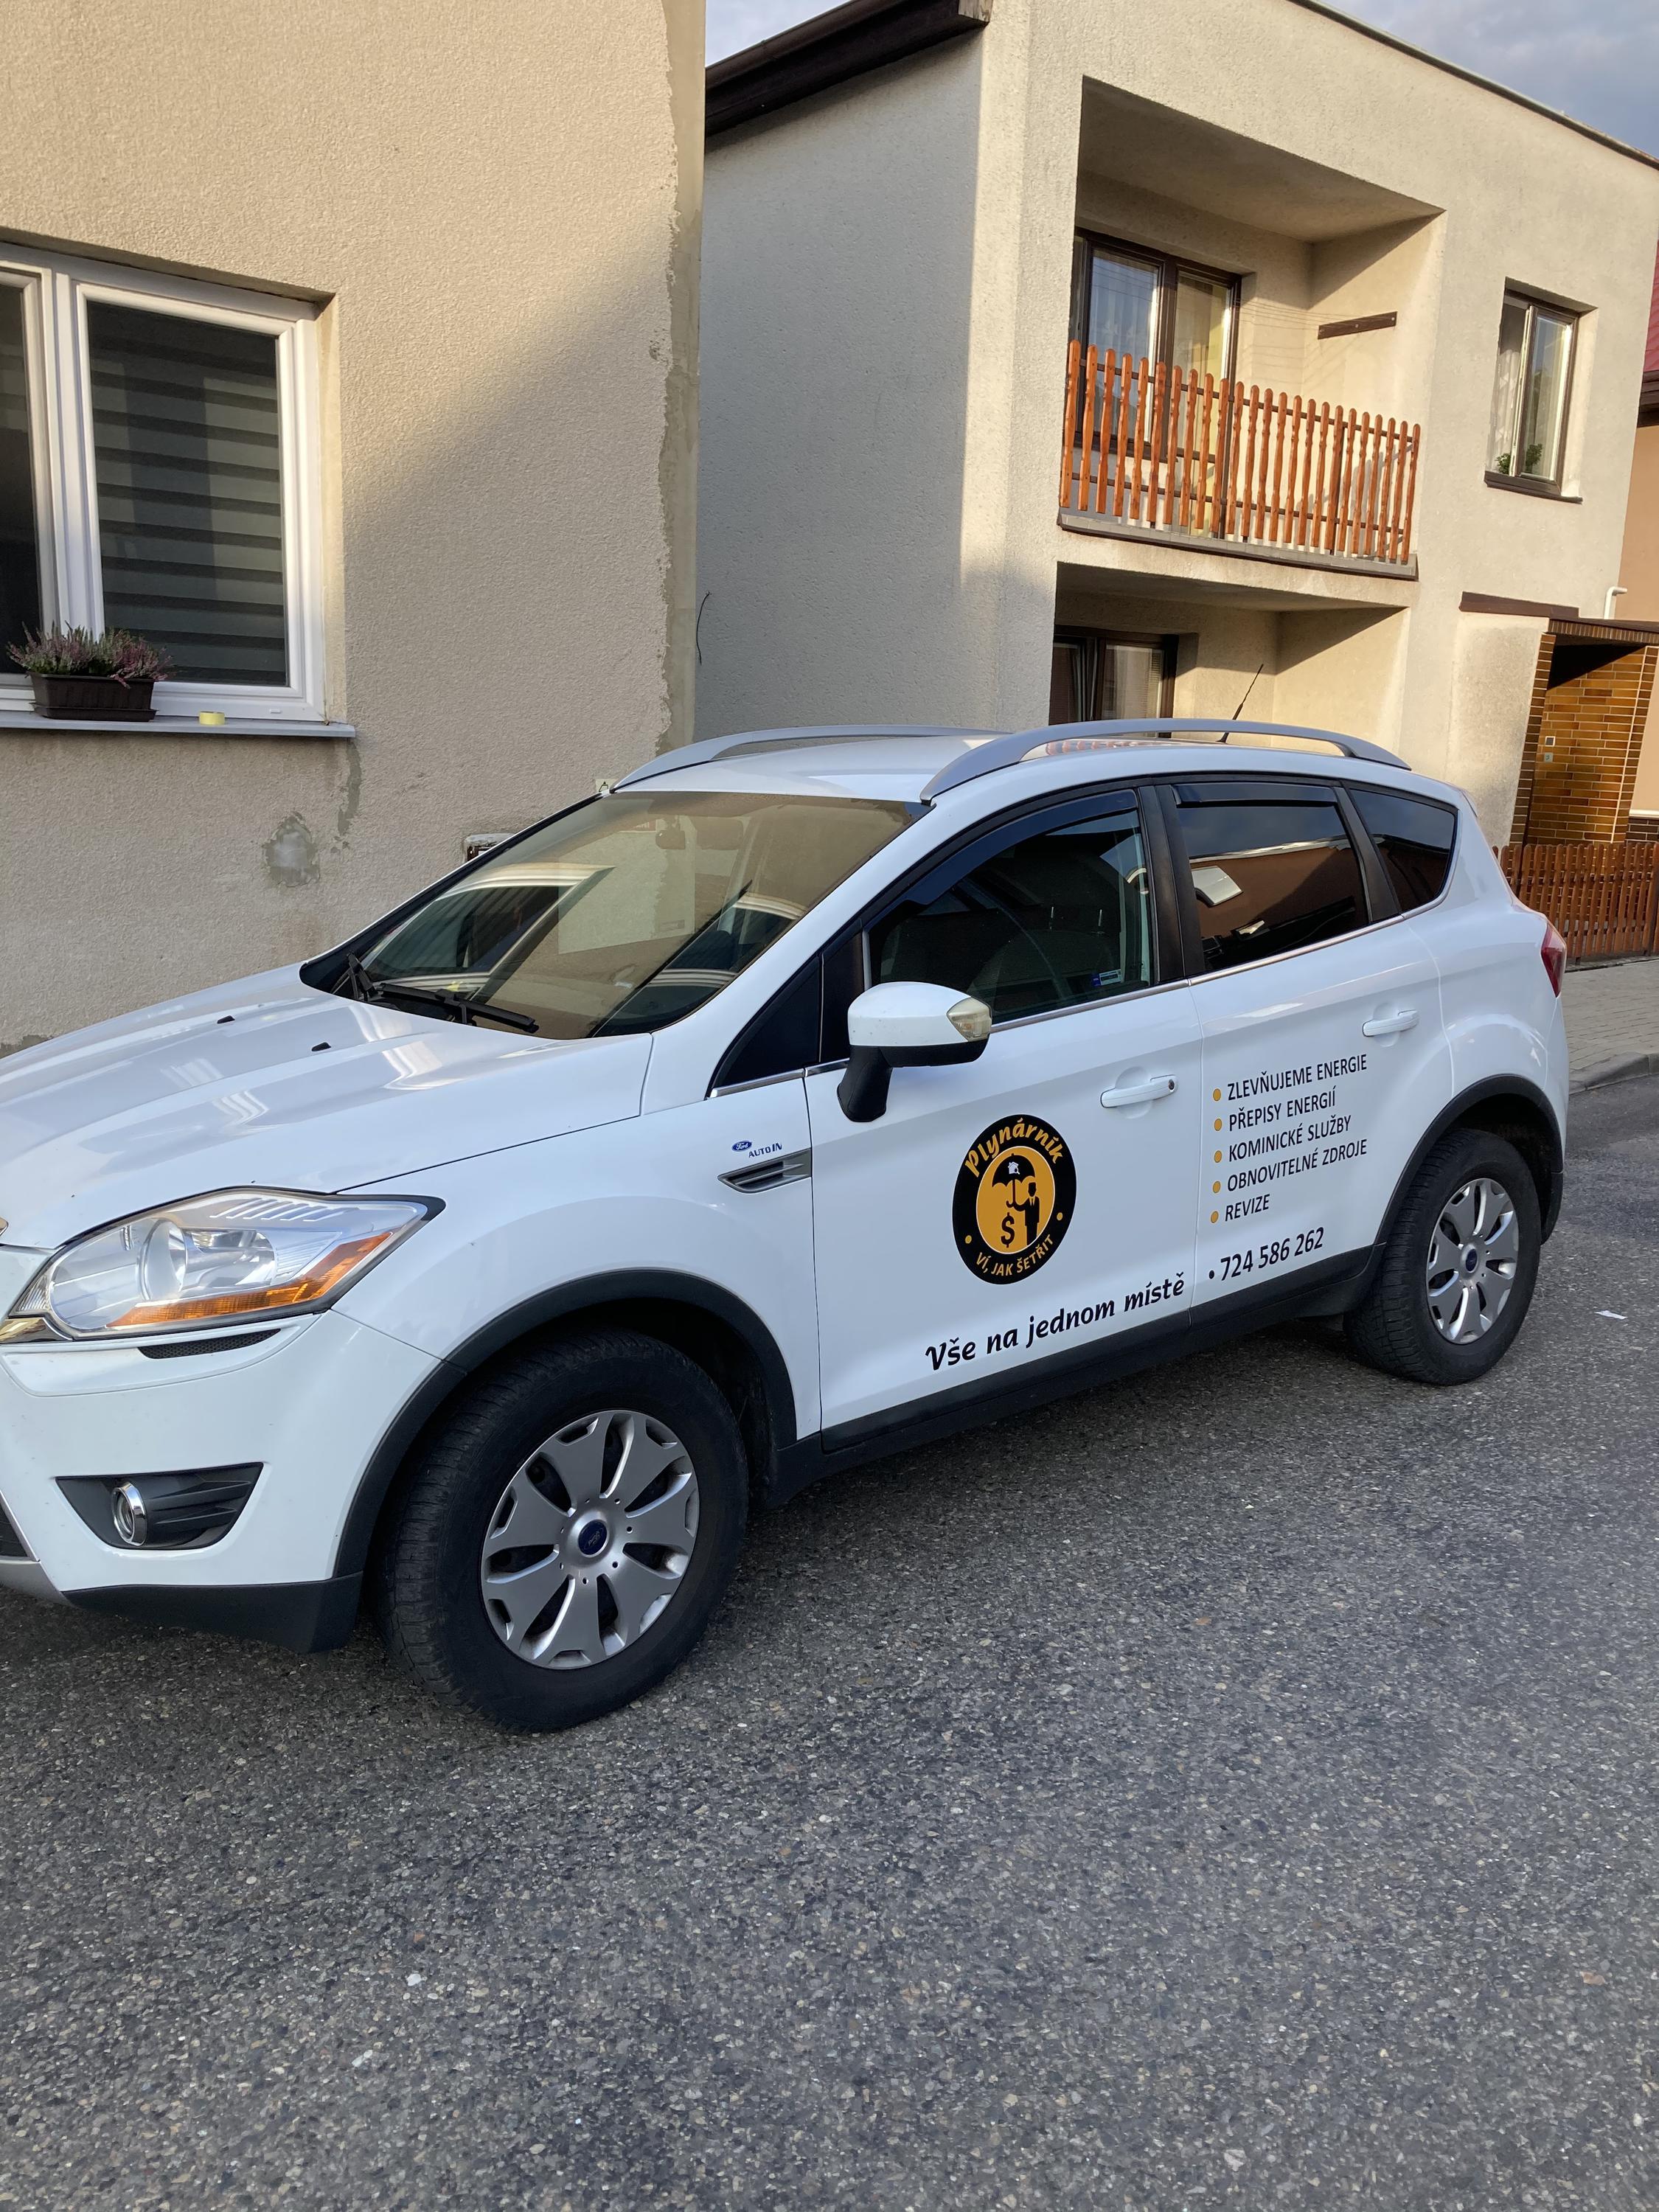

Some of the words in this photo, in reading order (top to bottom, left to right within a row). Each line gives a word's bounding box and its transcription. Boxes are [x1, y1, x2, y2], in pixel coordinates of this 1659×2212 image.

[1228, 1066, 1312, 1101] ZLEVŇUJEME
[1317, 1054, 1367, 1080] ENERGIE
[1229, 1103, 1281, 1131] PŘEPISY
[1287, 1085, 1336, 1117] ENERGIÍ
[965, 1117, 1062, 1178] Plynárník
[1228, 1123, 1303, 1162] KOMINICKÉ
[1307, 1115, 1352, 1141] SLUŽBY
[1227, 1148, 1318, 1192] OBNOVITELNÉ
[1322, 1139, 1367, 1166] ZDROJE
[1225, 1194, 1270, 1222] REVIZE
[976, 1252, 991, 1273] VÍ,
[991, 1262, 1013, 1276] JAK
[1016, 1234, 1053, 1273] ŠETŘIT
[1220, 1250, 1253, 1281] 724
[1258, 1238, 1290, 1269] 586
[1294, 1227, 1324, 1256] 262
[925, 1337, 976, 1371] Vše
[987, 1329, 1018, 1354] na
[1026, 1300, 1115, 1348] jednom
[1124, 1271, 1184, 1312] místě
